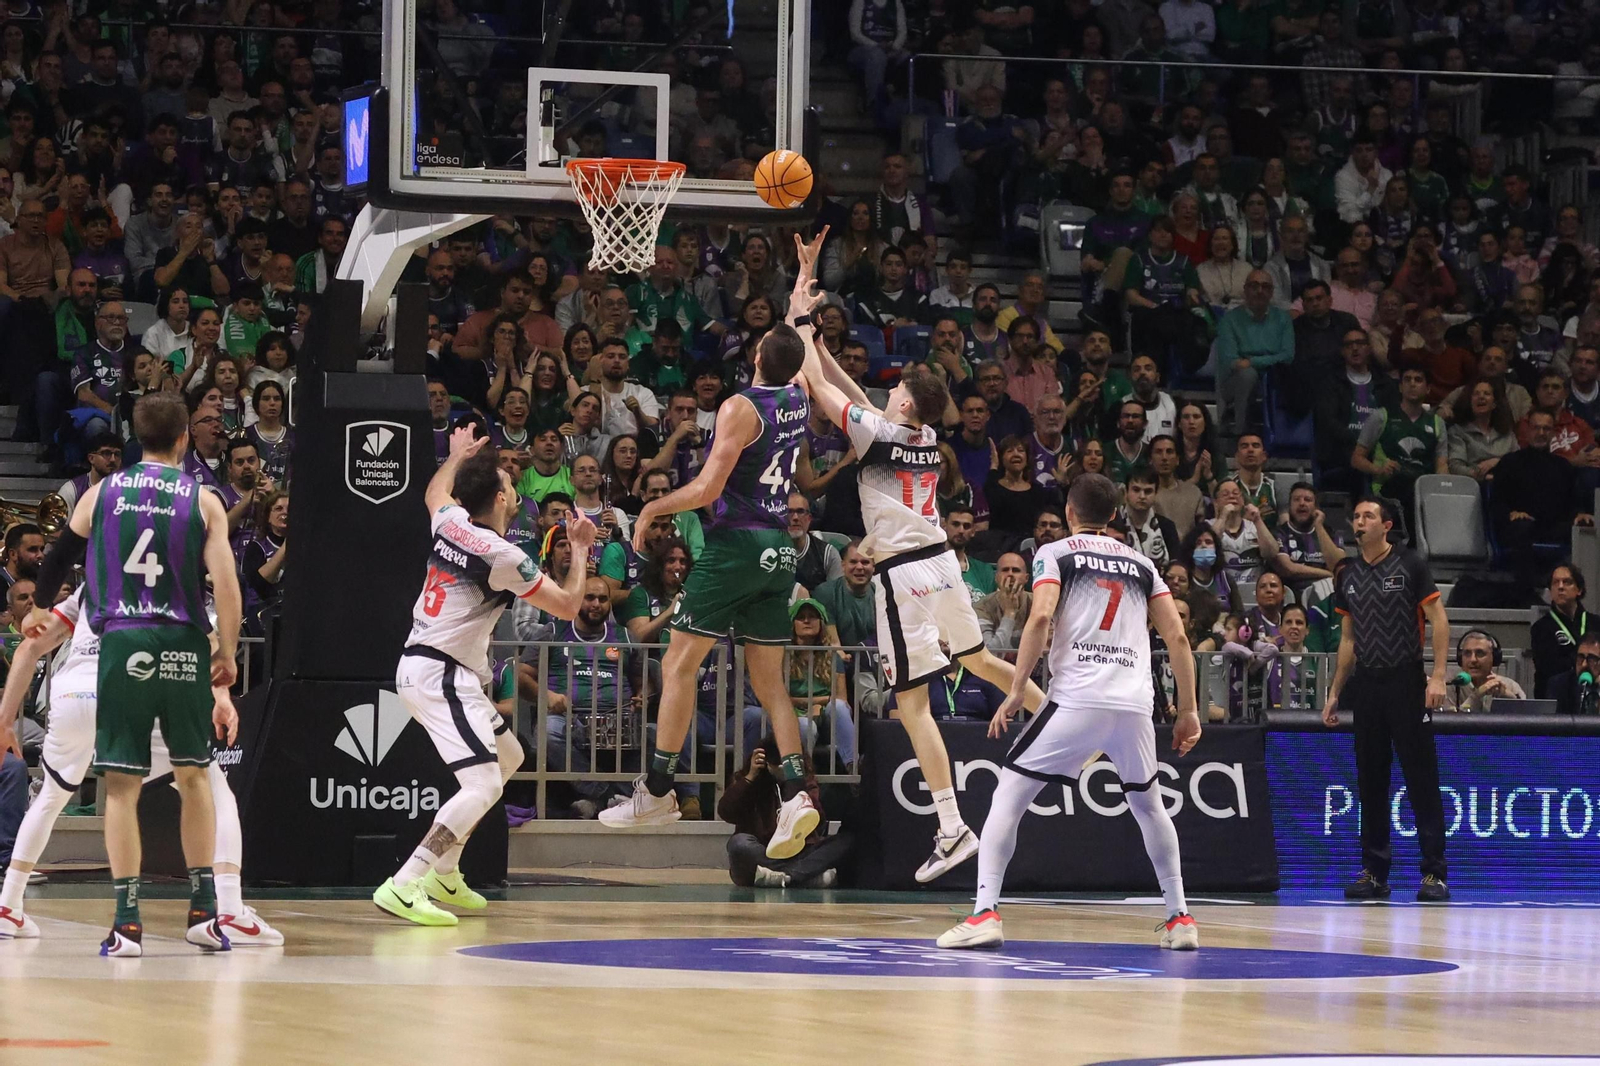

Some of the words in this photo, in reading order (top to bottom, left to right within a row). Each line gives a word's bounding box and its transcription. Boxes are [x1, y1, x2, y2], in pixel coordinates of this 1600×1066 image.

[416, 143, 437, 155] liga
[416, 153, 460, 165] endesa
[891, 445, 941, 465] PULEVA
[355, 460, 400, 470] Fundación
[355, 478, 400, 487] Baloncesto
[361, 469, 394, 481] Unicaja
[109, 471, 193, 498] Kalinoski
[895, 469, 937, 517] 12
[123, 527, 165, 589] 4
[433, 538, 469, 569] PULEVA
[1073, 553, 1141, 578] PULEVA
[1096, 577, 1124, 632] 7
[160, 650, 198, 664] COSTA
[1071, 641, 1139, 659] AYUNTAMIENTO
[159, 662, 180, 673] DEL
[181, 663, 198, 674] SOL
[1077, 653, 1092, 663] DE
[1093, 653, 1135, 669] GRANADA
[158, 670, 197, 682] MÁLAGA
[575, 666, 613, 679] máaga
[309, 776, 441, 821] Unicaja
[1323, 784, 1600, 839] PODUCTO
